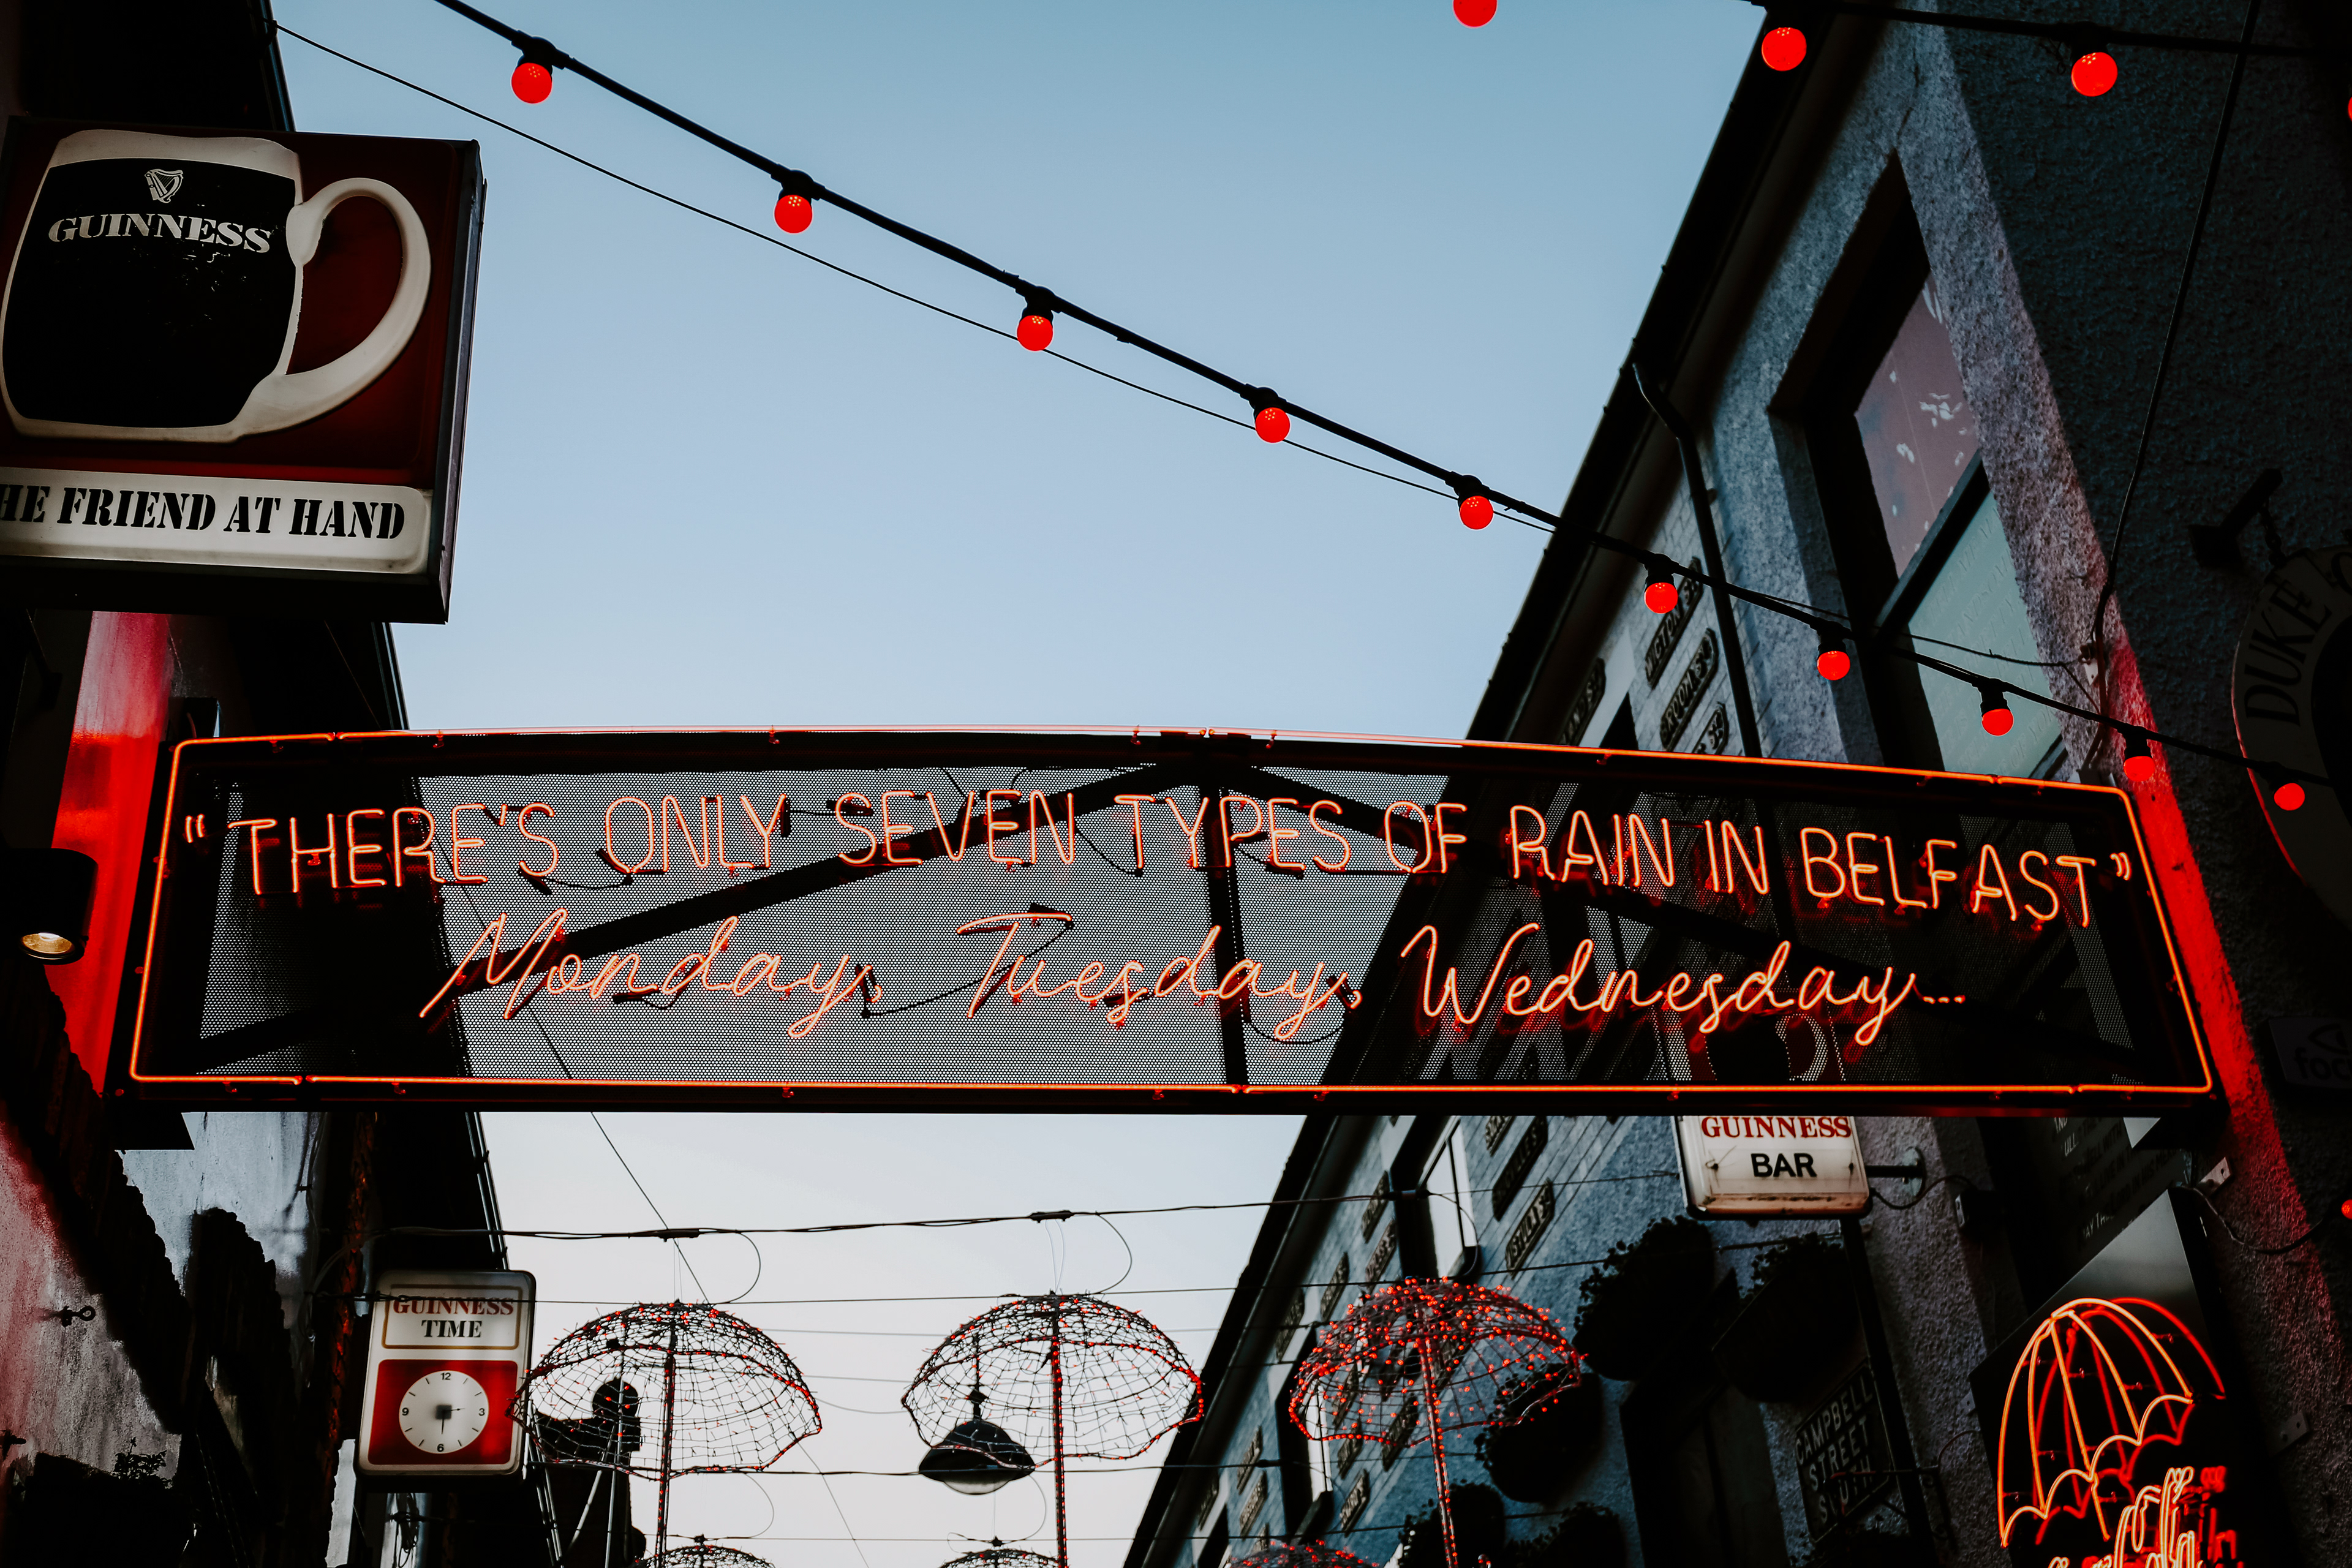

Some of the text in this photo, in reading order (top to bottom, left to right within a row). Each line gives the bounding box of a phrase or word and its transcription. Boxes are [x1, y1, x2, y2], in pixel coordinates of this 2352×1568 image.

[48, 213, 271, 254] GUINNESS
[0, 483, 405, 540] HE FRIEND AT HAND
[2244, 578, 2332, 728] DUKE
[605, 794, 787, 875] ONLY
[834, 789, 1076, 867] SEVEN
[1114, 796, 1351, 871] TYPES
[1384, 800, 1468, 873] OF
[1510, 805, 1675, 887] RAIN
[1704, 819, 1769, 895] IN
[1800, 827, 2132, 927] BELFAST"
[420, 908, 1967, 1046] Monday, Tuesday, Wednesday...
[1702, 1116, 1851, 1139] GUINNESS
[1751, 1153, 1817, 1177] BAR
[393, 1296, 514, 1316] GUINNESS
[421, 1319, 483, 1338] TIME
[440, 1372, 451, 1381] 12
[401, 1408, 486, 1417] 9 3
[1795, 1374, 1874, 1466] CAMPBELL
[437, 1444, 444, 1452] 6
[1809, 1414, 1868, 1492] STREET
